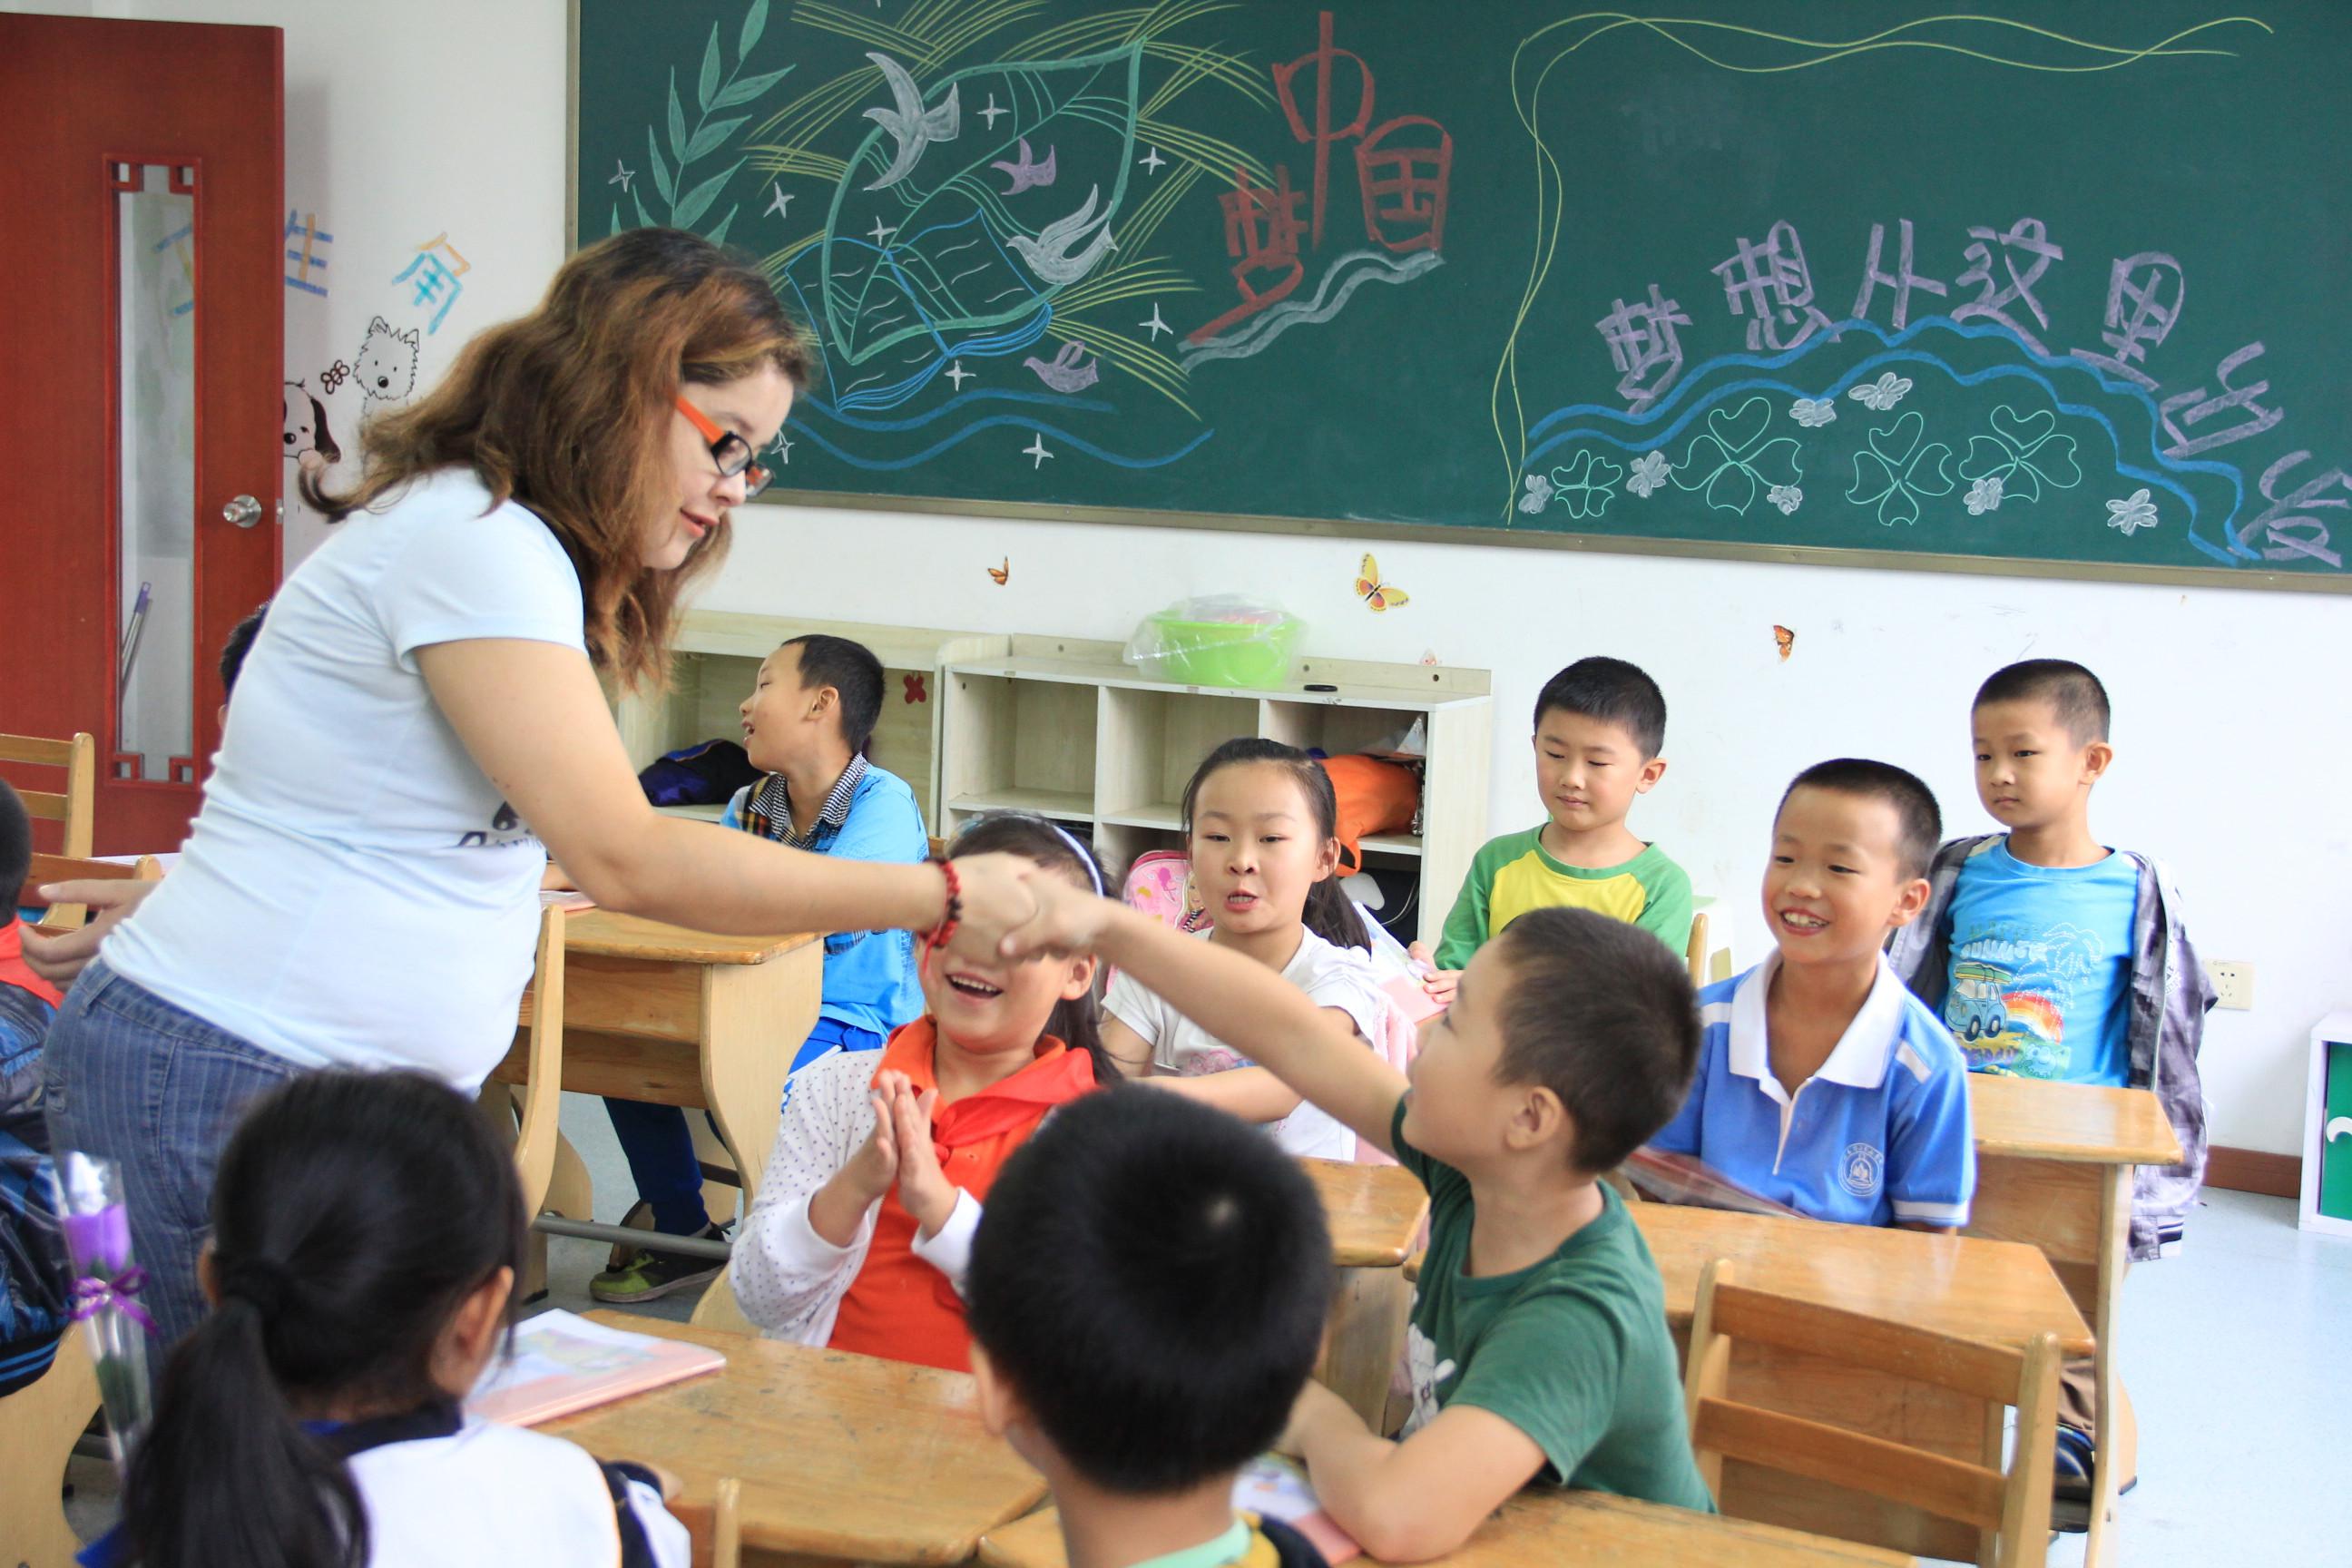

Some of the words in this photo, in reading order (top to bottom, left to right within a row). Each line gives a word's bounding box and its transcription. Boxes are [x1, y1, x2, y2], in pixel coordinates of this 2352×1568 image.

[1189, 11, 1452, 343] 中国梦
[1594, 219, 2352, 568] 梦想从这里出发
